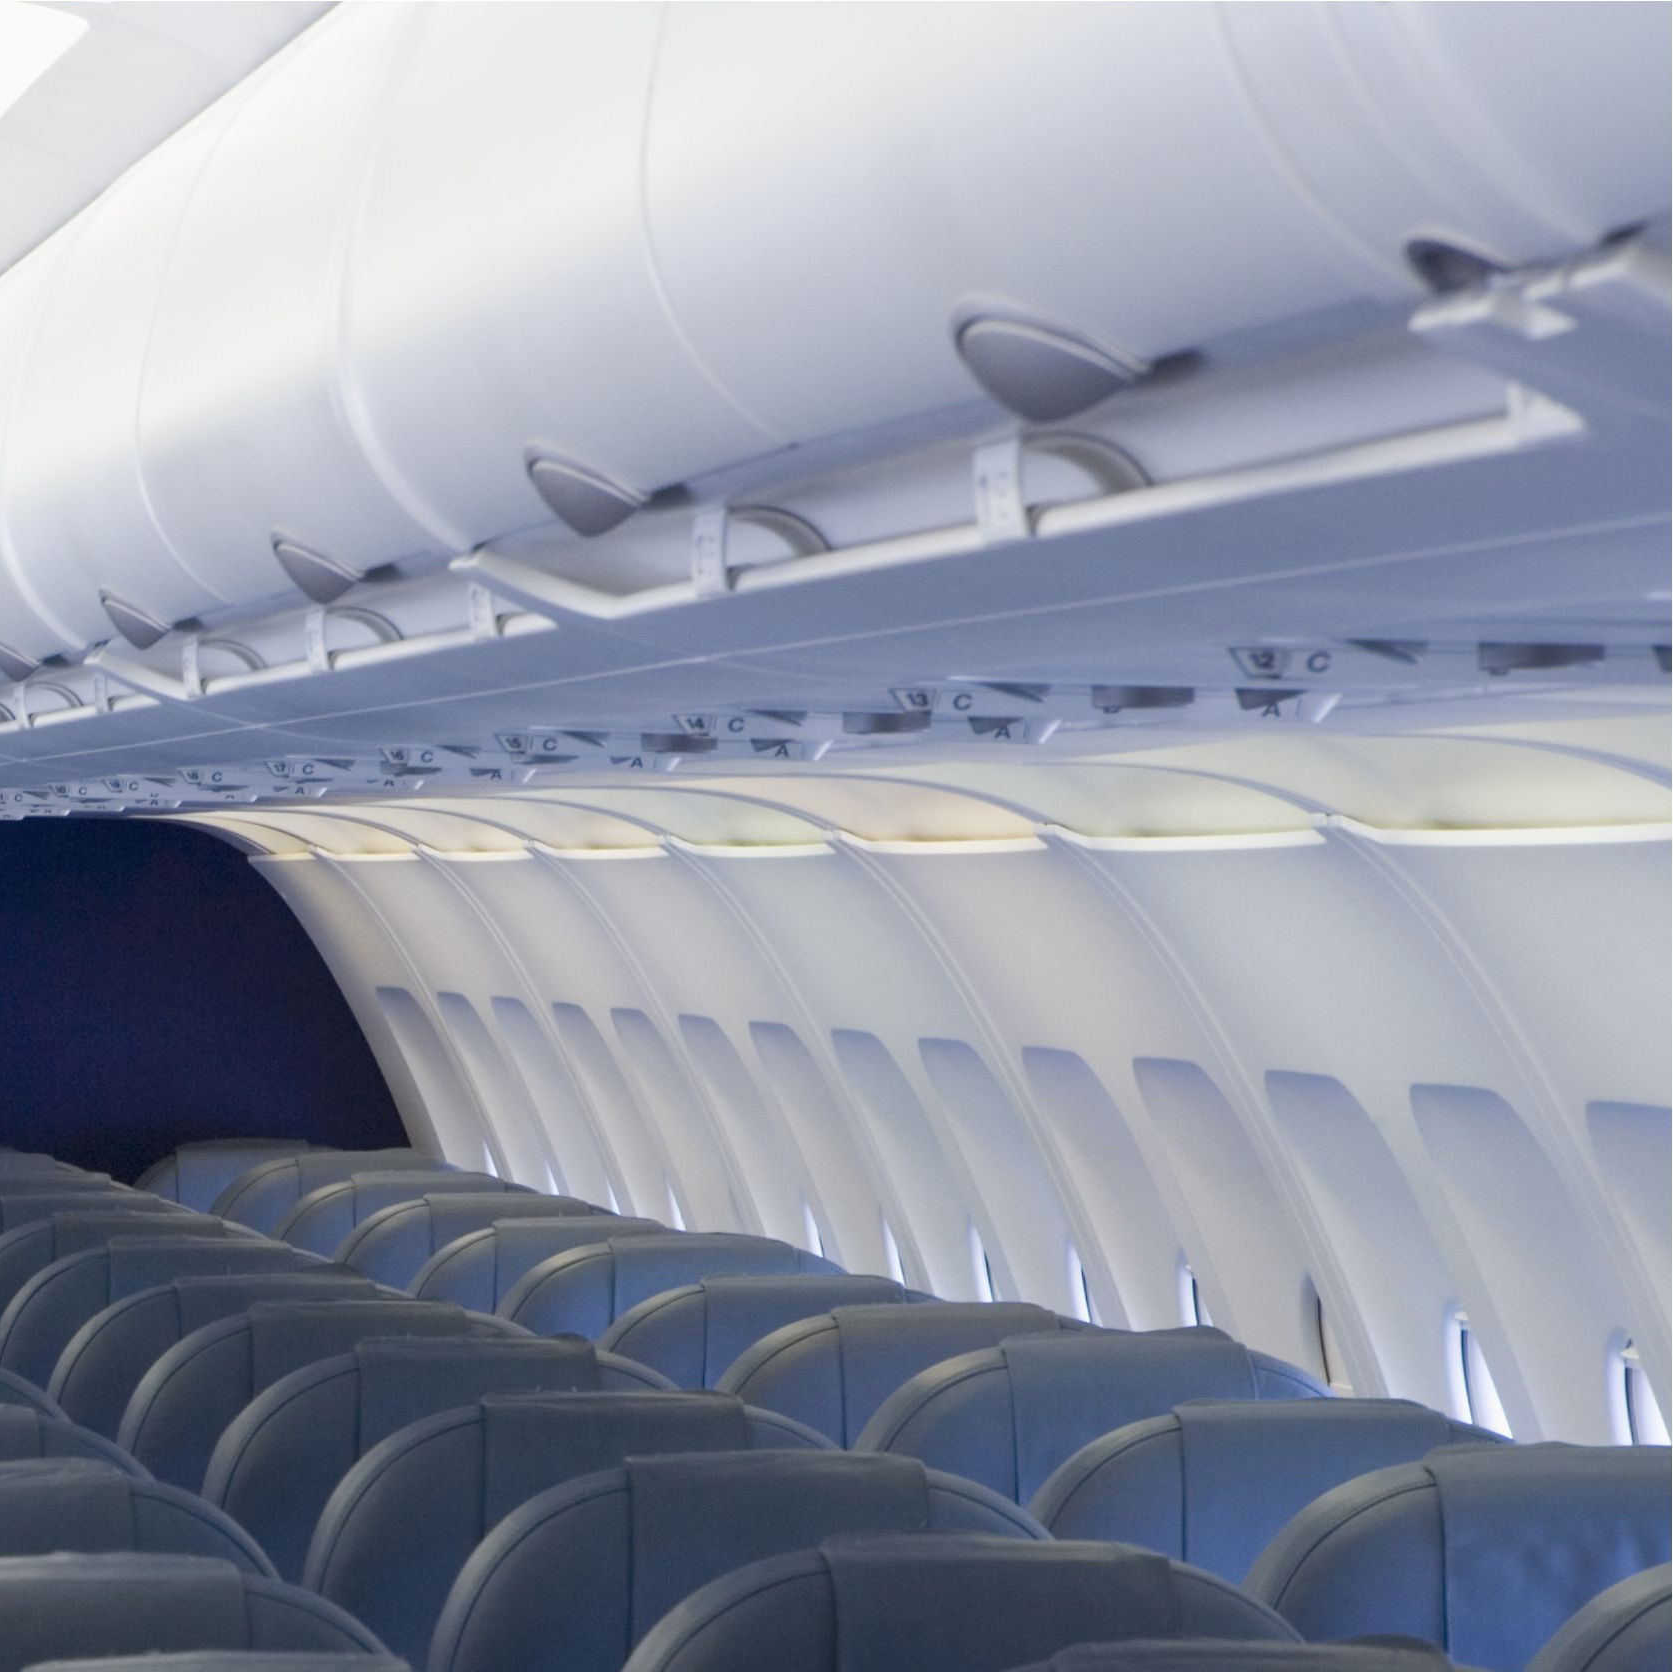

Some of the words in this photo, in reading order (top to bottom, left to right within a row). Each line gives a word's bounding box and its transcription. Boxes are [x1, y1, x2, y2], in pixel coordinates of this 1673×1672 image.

[1250, 652, 1274, 670] 12
[1307, 650, 1330, 673] C
[907, 693, 928, 707] 13
[954, 694, 972, 711] C
[686, 717, 704, 730] 14
[728, 718, 744, 733] C
[994, 723, 1011, 738] A
[506, 738, 521, 749] 15
[543, 738, 557, 751] C
[775, 743, 789, 757] A
[421, 751, 433, 763] C
[630, 757, 643, 768] A
[302, 764, 314, 775] C
